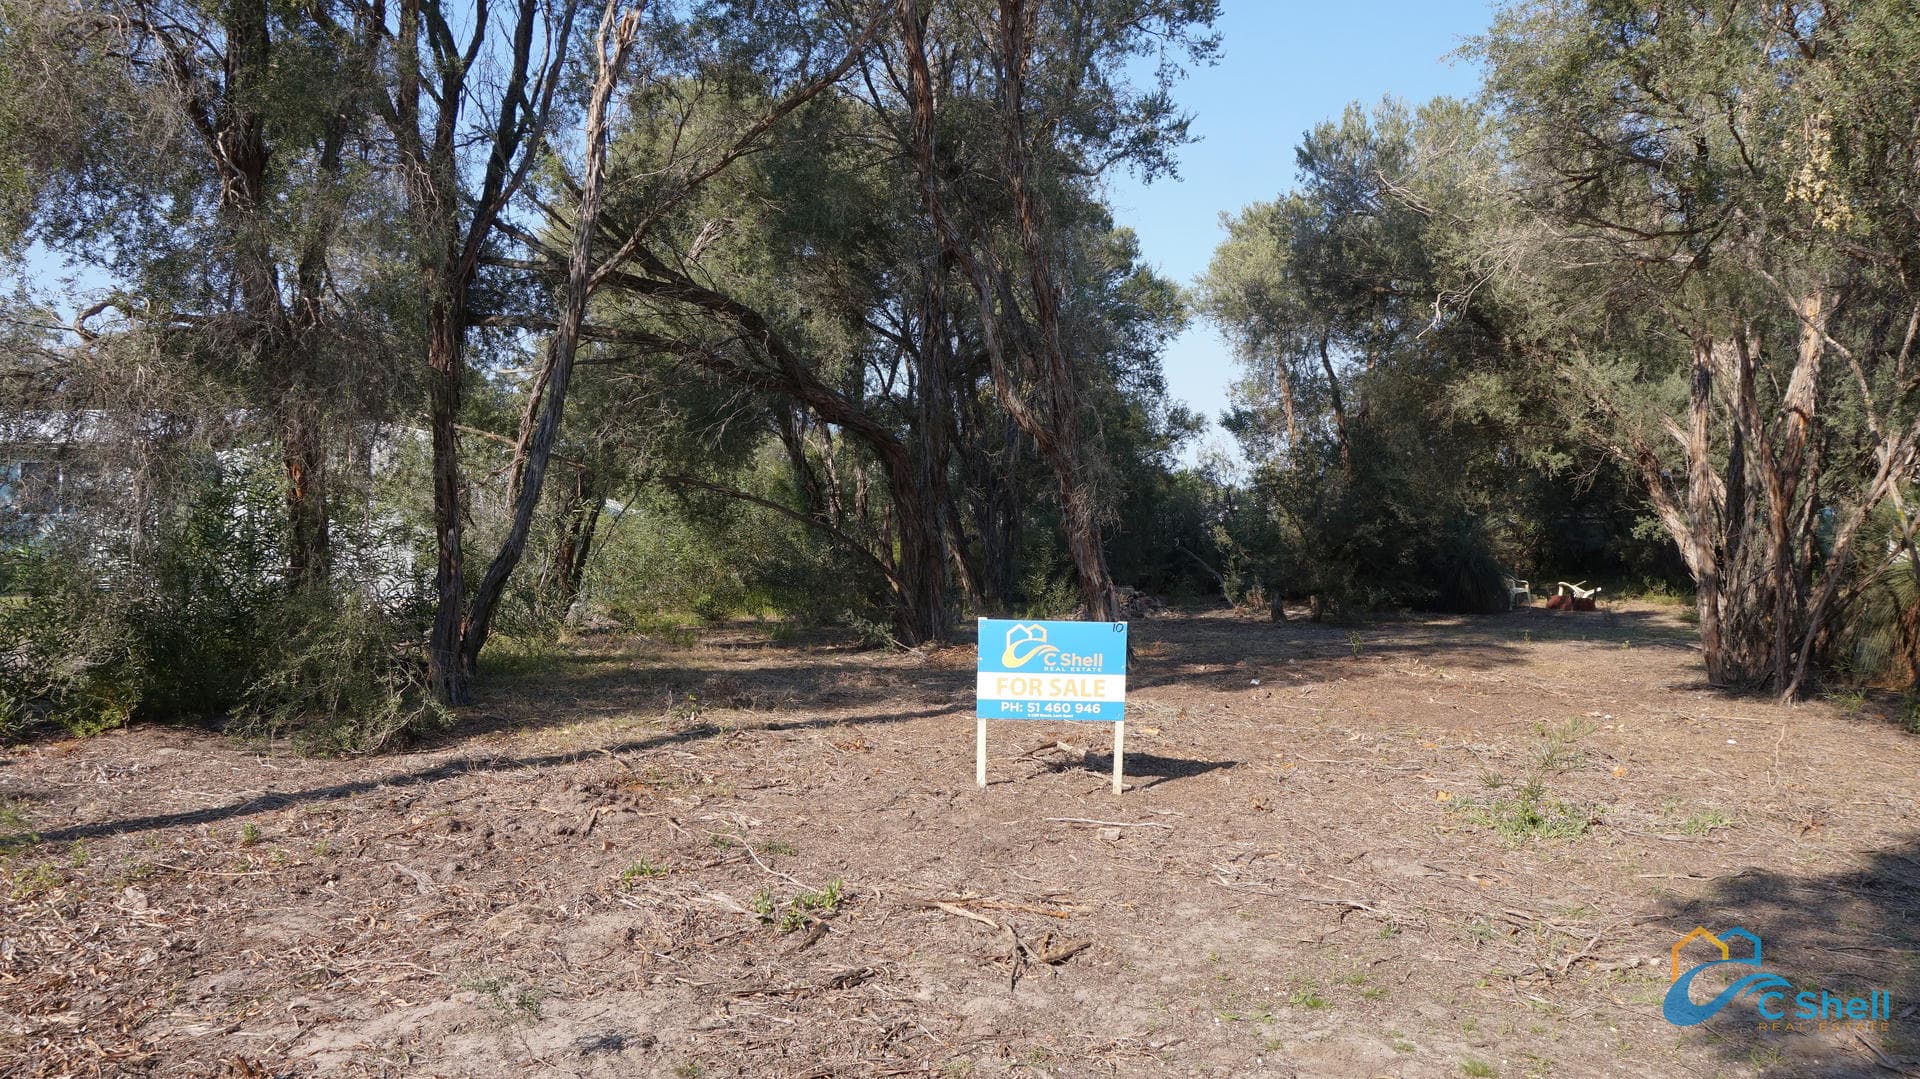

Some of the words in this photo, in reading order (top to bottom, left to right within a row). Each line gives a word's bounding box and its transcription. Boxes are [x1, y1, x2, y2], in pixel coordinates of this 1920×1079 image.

[1112, 623, 1124, 633] 10
[1043, 653, 1056, 666] C
[1060, 653, 1103, 667] Shell
[996, 677, 1042, 697] FOR
[1049, 678, 1106, 698] SALE
[1001, 702, 1023, 712] PH:
[1027, 702, 1040, 713] 51
[1044, 703, 1071, 713] 460
[1075, 703, 1101, 714] 946
